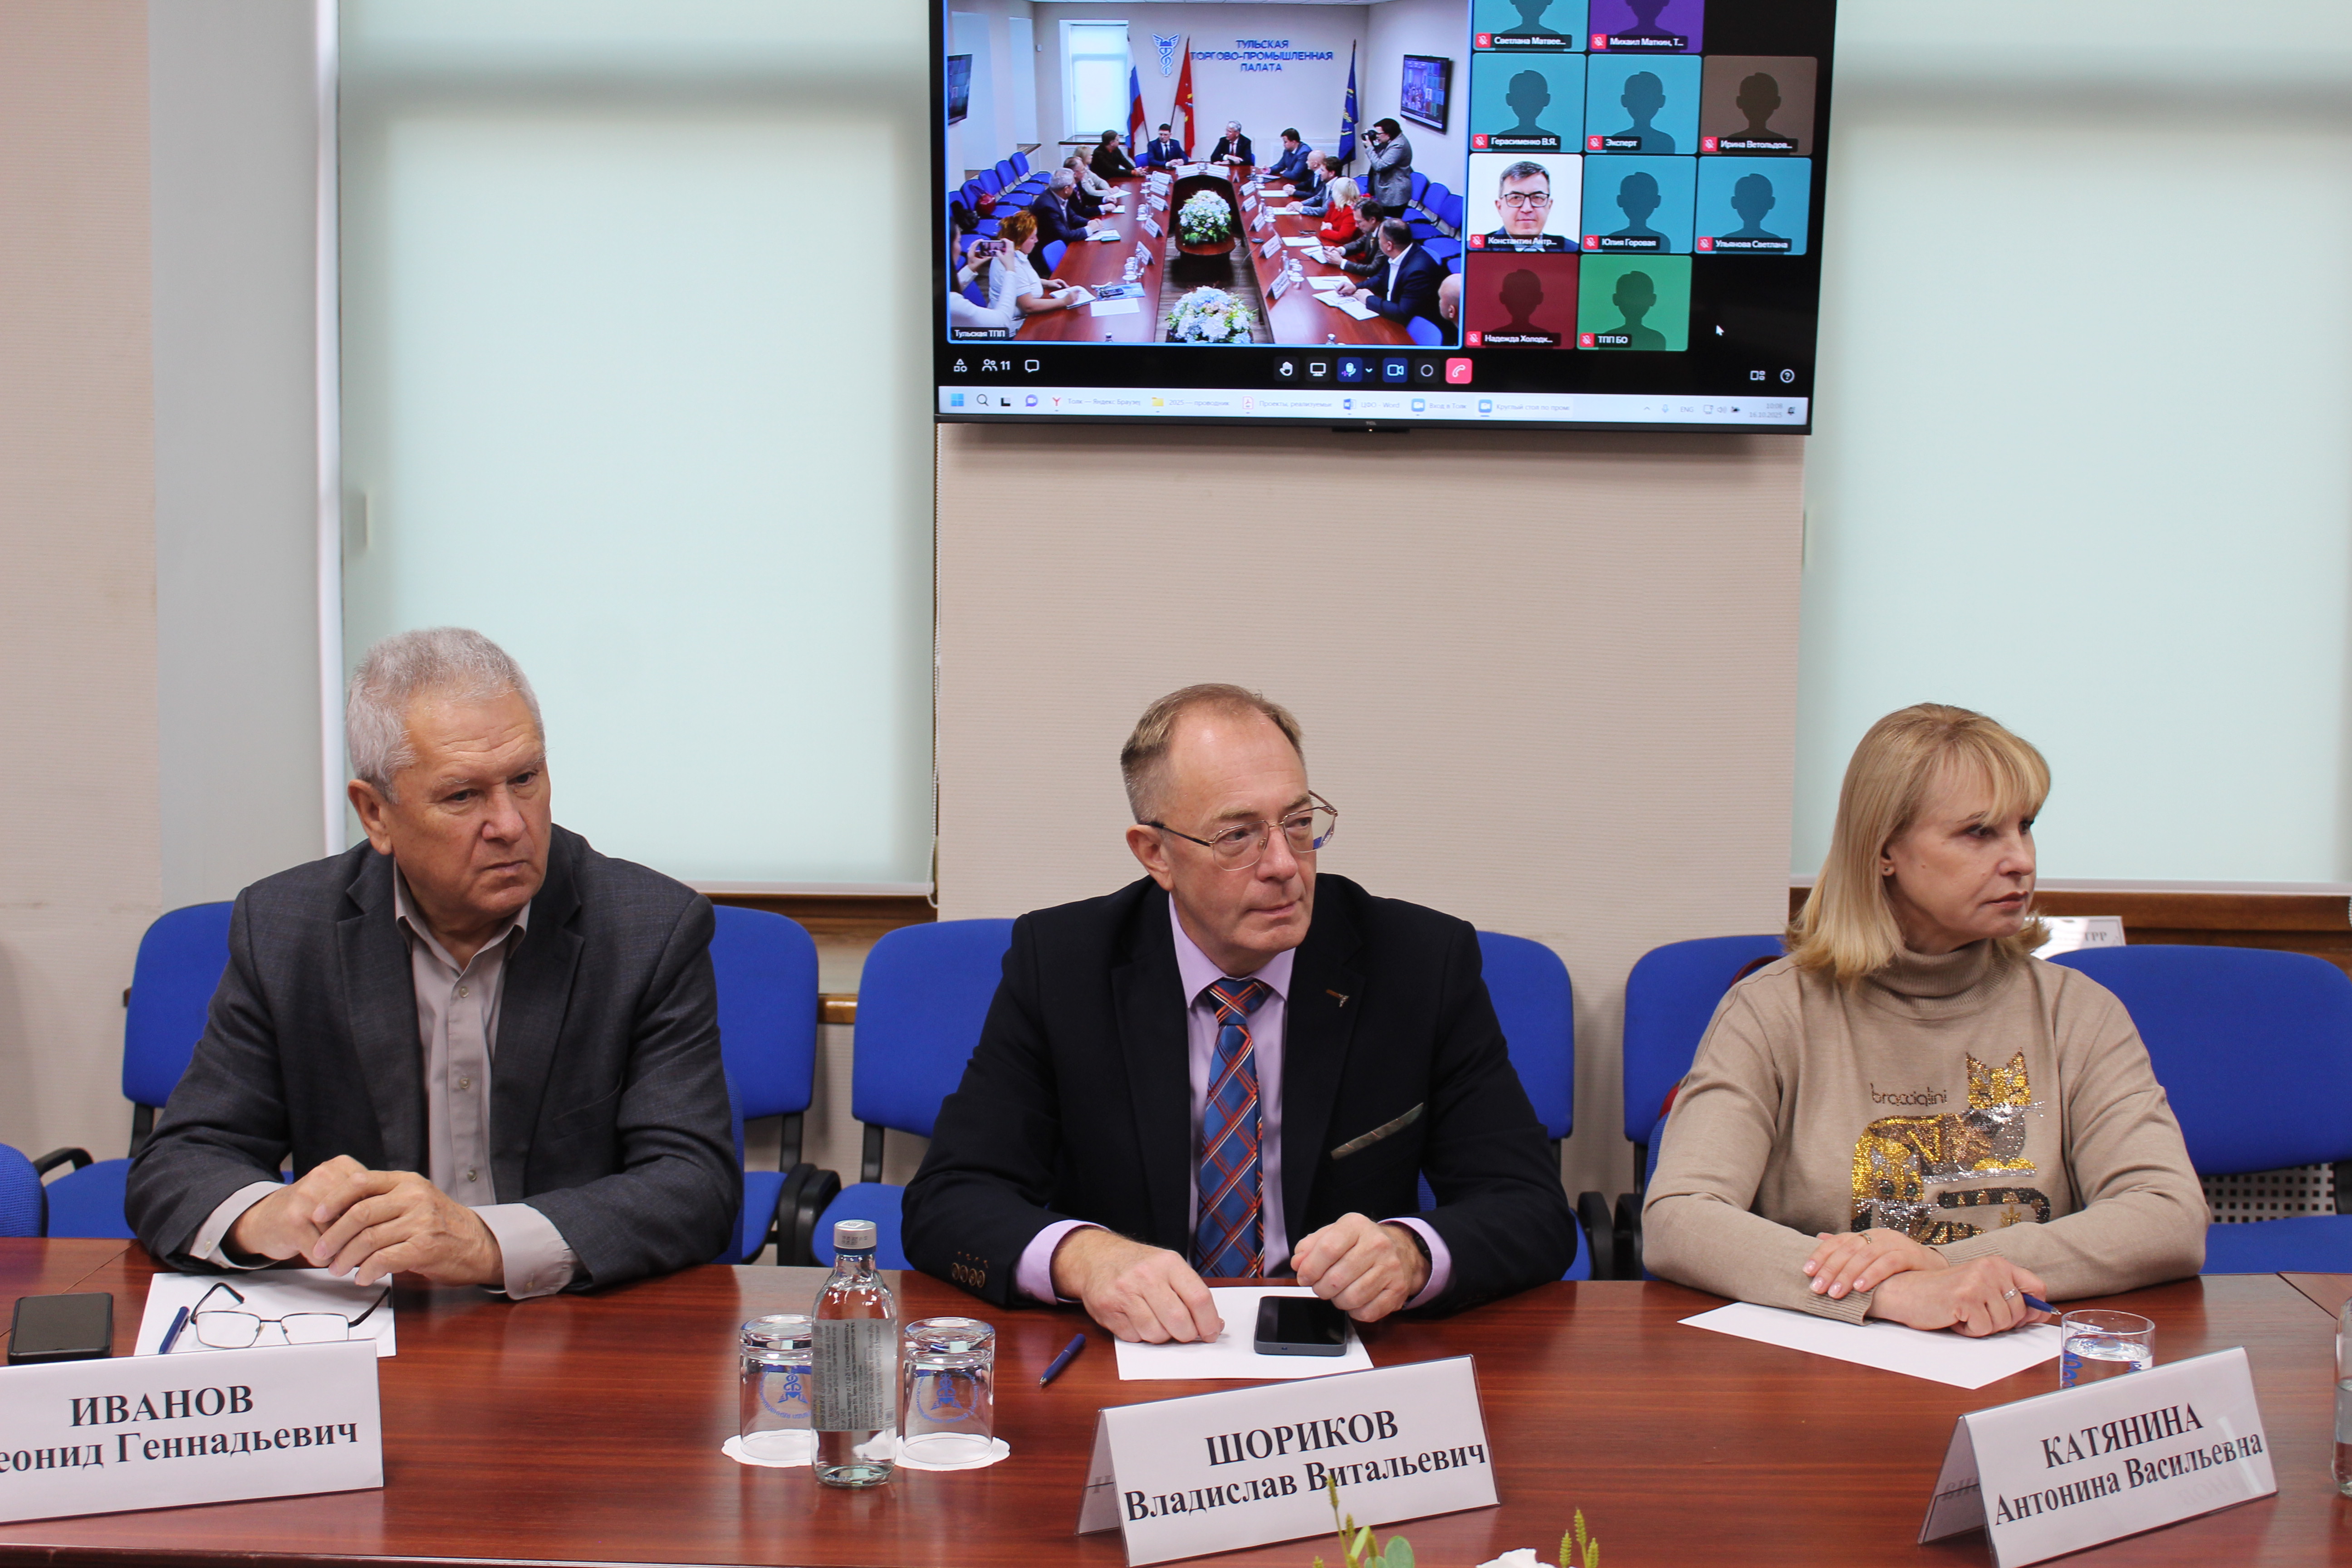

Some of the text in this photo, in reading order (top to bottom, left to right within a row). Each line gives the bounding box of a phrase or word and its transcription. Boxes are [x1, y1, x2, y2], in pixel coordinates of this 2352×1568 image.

[1235, 39, 1289, 49] ТУЛЬСКАЯ
[1494, 36, 1531, 44] Светлана
[1190, 51, 1333, 60] ТОРГОВО-ПРОМЫШЛЕННАЯ
[1240, 63, 1282, 72] ПАЛАТА
[1491, 138, 1541, 146] Герасименко
[1605, 139, 1638, 147] Эксперт
[1720, 140, 1746, 149] Ирина
[1625, 239, 1656, 247] Горовая
[1715, 240, 1752, 248] Ульянова
[954, 329, 988, 338] Тульская
[1485, 334, 1519, 343] Надежда
[1000, 361, 1010, 370] 11
[68, 1385, 253, 1427] ИВАНОВ
[1205, 1410, 1398, 1466] ШОРИКОВ
[2040, 1402, 2204, 1469] КАТЯНИНА
[0, 1422, 358, 1474] еонид Геннадьевич
[1124, 1474, 1297, 1521] Владислав
[1305, 1443, 1486, 1492] Витальевич
[1995, 1470, 2121, 1525] Антонина
[2123, 1431, 2263, 1489] Васильевна
